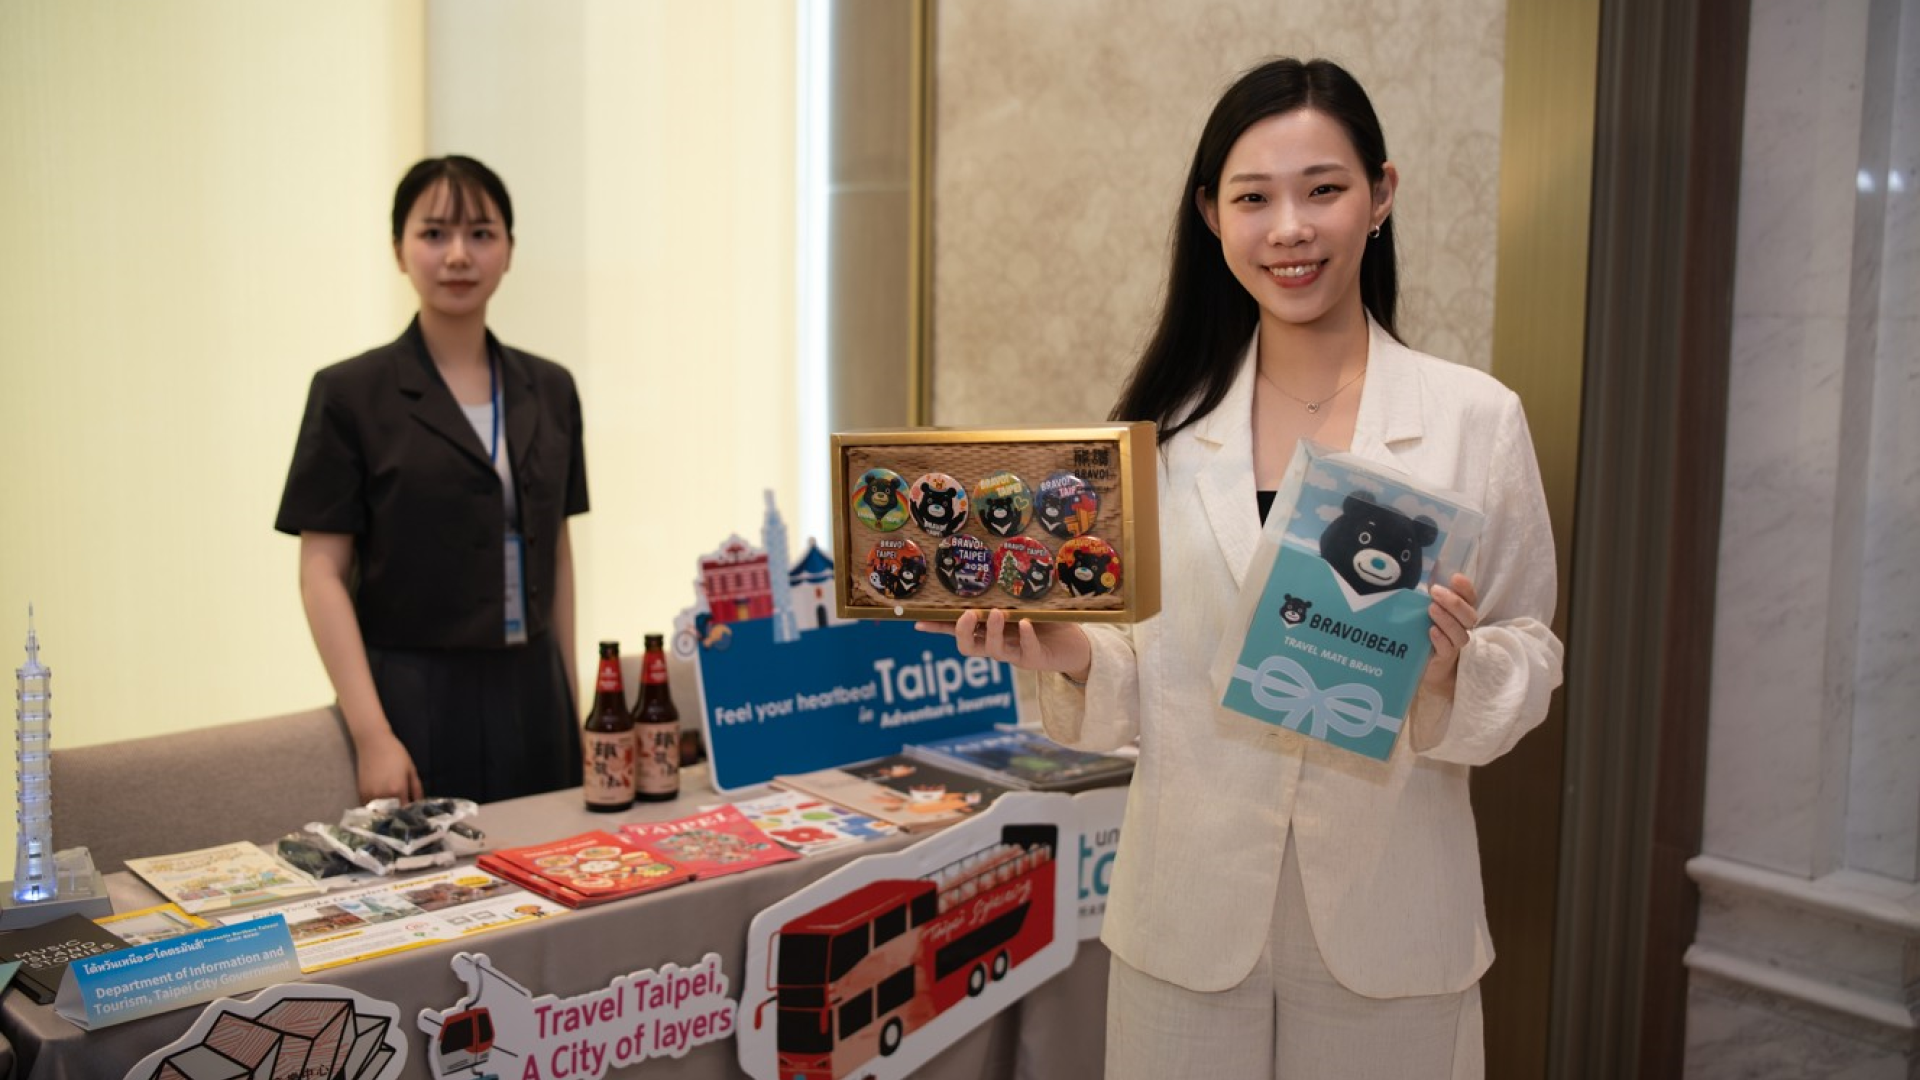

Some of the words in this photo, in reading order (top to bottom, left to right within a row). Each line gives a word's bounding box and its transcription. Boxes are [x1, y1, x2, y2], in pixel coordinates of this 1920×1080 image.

[1041, 477, 1070, 491] BRAVO!
[1074, 469, 1109, 480] BRAVO!
[876, 550, 897, 558] TAIPEI
[880, 539, 905, 548] BRAVO!
[951, 537, 984, 549] BRAVO!
[958, 549, 986, 562] TAIPEI
[1309, 614, 1408, 659] BRAVO!BEAR
[1284, 636, 1318, 655] TRAVEL
[1320, 649, 1348, 666] MATE
[1348, 659, 1383, 677] BRAVO
[715, 705, 753, 726] Feel
[755, 697, 794, 722] your
[796, 681, 877, 710] heartbeat
[874, 651, 1002, 704] Taipei
[880, 704, 955, 728] Adventure
[957, 692, 1011, 712] Journey
[14, 939, 80, 958] MUSIC
[22, 941, 96, 964] ISLAND
[29, 942, 115, 969] STORIES
[96, 972, 173, 999] Department
[175, 965, 189, 979] of
[190, 953, 261, 977] Information
[263, 946, 285, 959] and
[93, 993, 152, 1016] Tourism,
[153, 984, 193, 1001] Taipei
[194, 976, 219, 994] City
[220, 961, 290, 985] Government
[535, 986, 624, 1039] Travel
[634, 962, 723, 1012] Taipei,
[521, 1054, 543, 1080] A
[551, 1039, 607, 1078] City
[615, 1024, 645, 1060] of
[653, 1007, 732, 1050] layers
